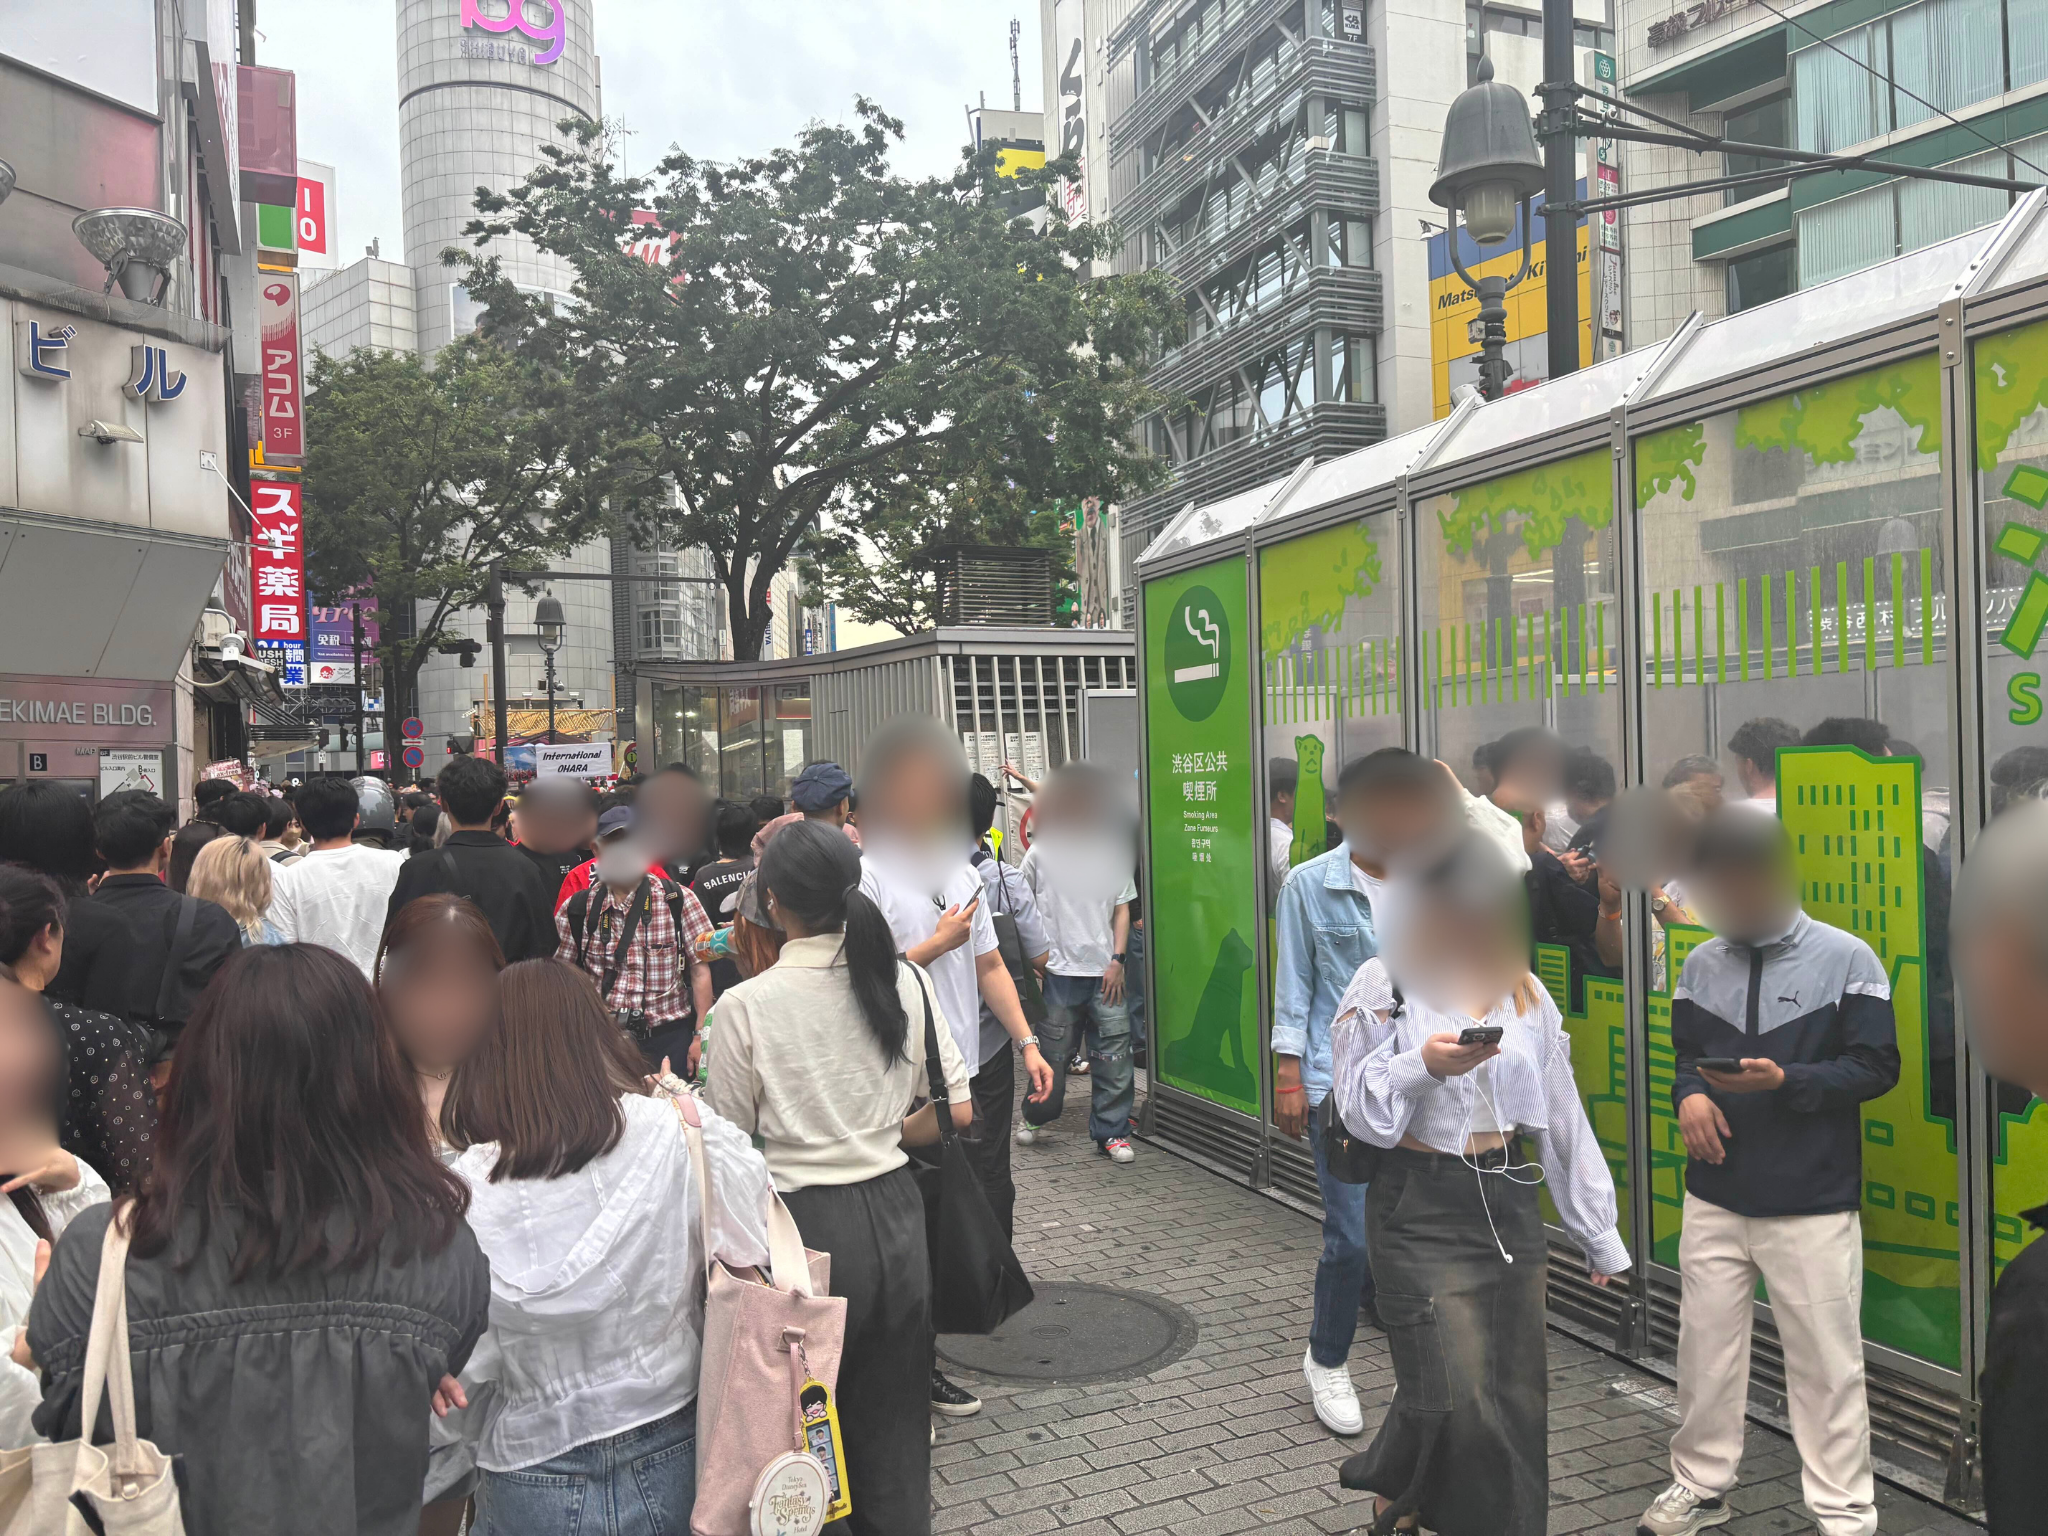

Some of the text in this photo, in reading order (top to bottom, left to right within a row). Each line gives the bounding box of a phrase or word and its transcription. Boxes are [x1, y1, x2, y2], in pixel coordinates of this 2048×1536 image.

[29, 319, 188, 401] ビル
[266, 348, 295, 419] アコム
[273, 427, 293, 439] 3F
[256, 487, 300, 634] スギ薬局
[283, 641, 302, 649] hour
[258, 649, 284, 659] USH
[284, 665, 304, 685] 業
[2007, 672, 2043, 726] S
[0, 699, 157, 726] EKIMAE BLDG.
[33, 755, 43, 770] B
[542, 750, 602, 761] International
[1172, 750, 1228, 774] 渋谷区公共
[557, 764, 588, 773] OHARA
[1183, 780, 1217, 802] 喫煙所
[1183, 810, 1218, 821] Smoking Area
[1184, 823, 1219, 833] Zone Fumeurs
[787, 1476, 804, 1484] Tokyo
[768, 1491, 812, 1512] Fantasy
[770, 1506, 816, 1526] Springs
[793, 1524, 808, 1534] Hotel
